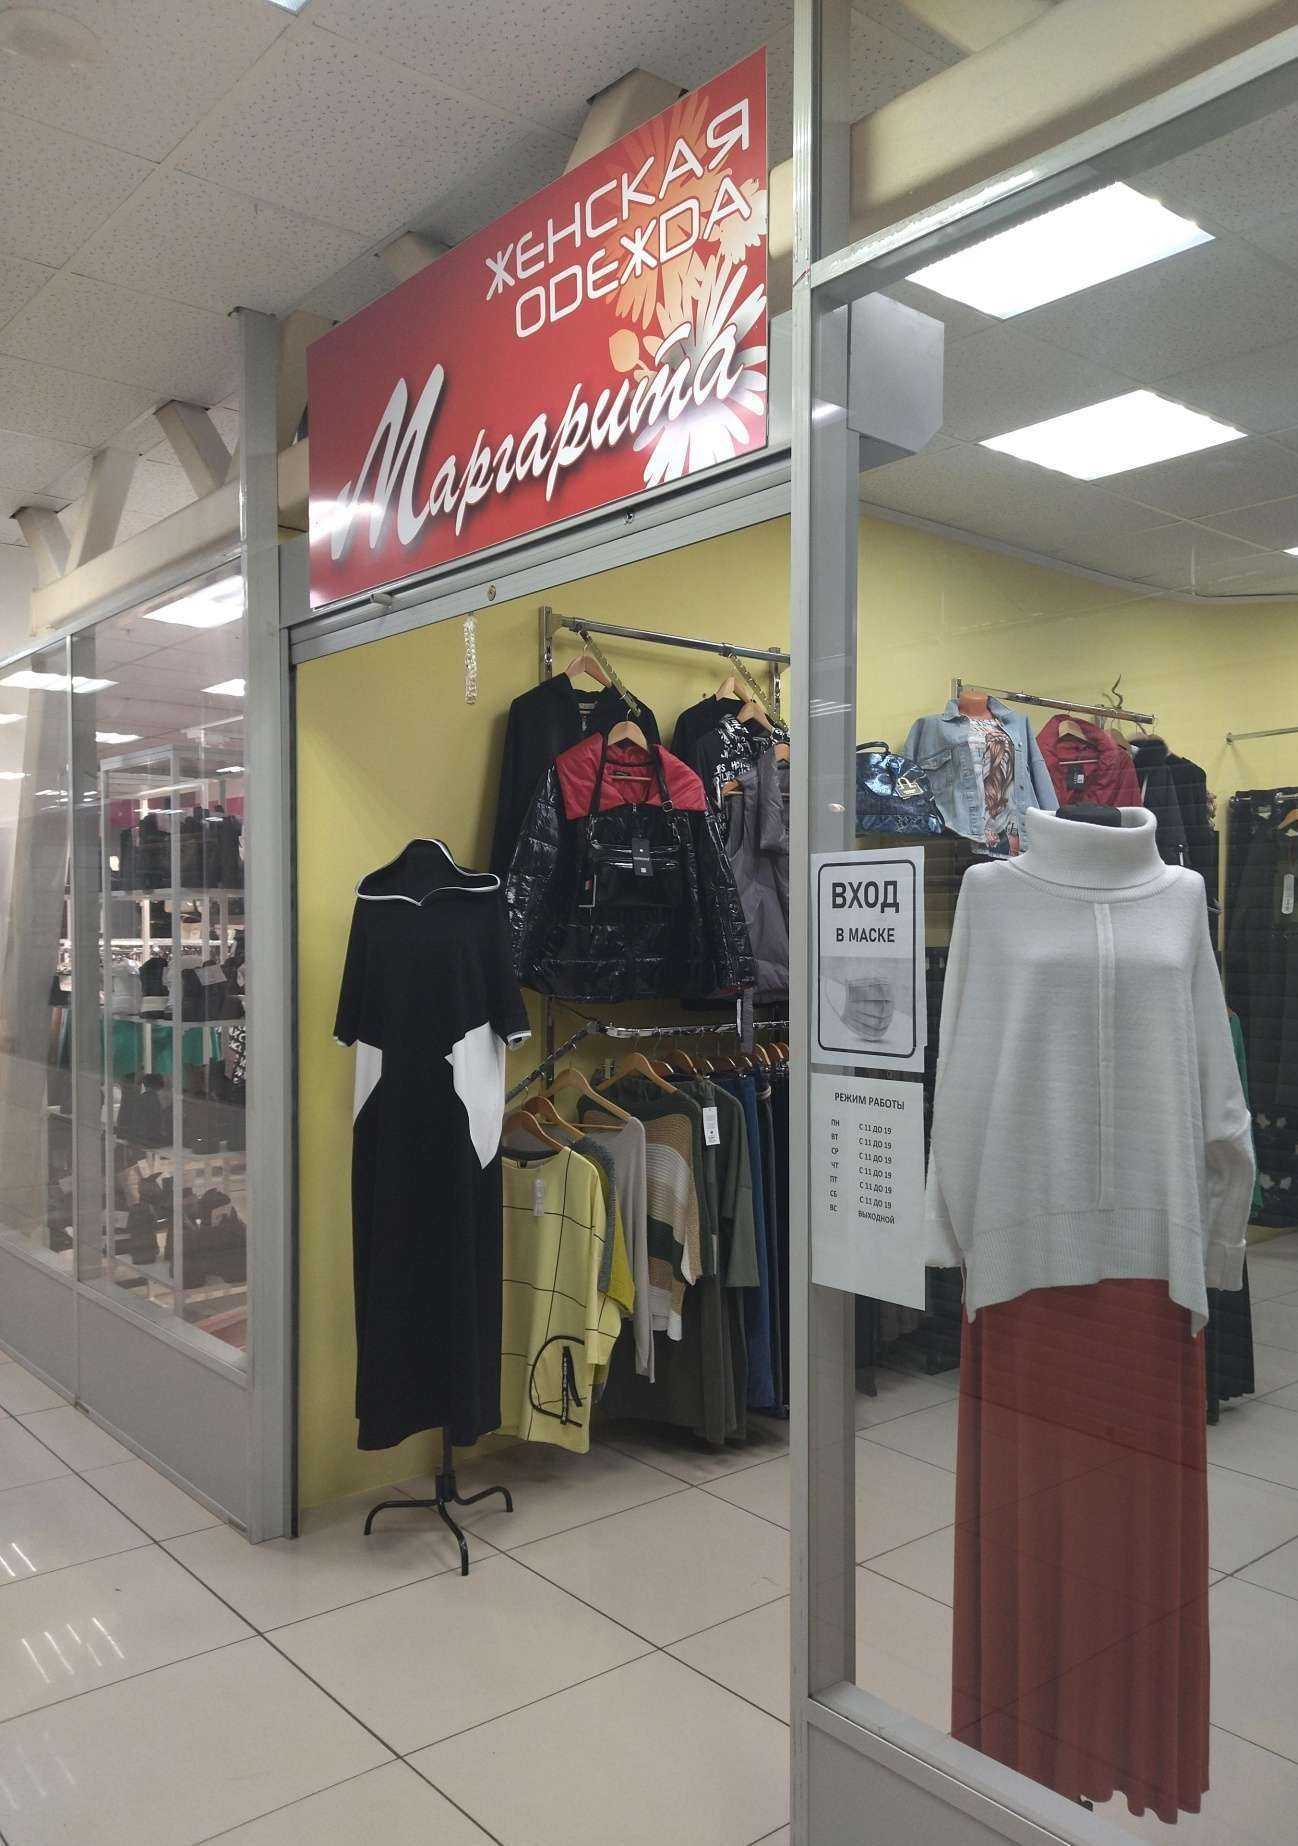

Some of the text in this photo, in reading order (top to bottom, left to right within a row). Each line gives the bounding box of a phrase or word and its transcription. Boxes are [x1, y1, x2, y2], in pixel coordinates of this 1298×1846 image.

[485, 98, 751, 301] ЖЕНСКАЯ
[515, 177, 752, 339] ОДЕЖДА
[331, 322, 745, 561] Маргарита
[831, 880, 900, 913] ВХОД
[836, 927, 896, 943] В МАСКЕ
[834, 1092, 905, 1110] РЕЖИМ РАБОТЫ
[831, 1119, 840, 1127] ПН
[865, 1124, 872, 1132] 11
[872, 1125, 883, 1134] ДО
[884, 1127, 892, 1135] 19
[831, 1133, 839, 1141] ВТ
[865, 1138, 872, 1147] 11
[872, 1140, 883, 1149] ДО
[884, 1141, 892, 1150] 19
[831, 1147, 839, 1155] СР
[865, 1153, 872, 1161] 11
[872, 1154, 883, 1164] ДО
[884, 1156, 892, 1165] 19
[831, 1161, 839, 1169] ЧТ
[865, 1167, 872, 1176] 11
[872, 1169, 884, 1179] ДО
[884, 1171, 892, 1180] 19
[829, 1175, 838, 1184] ПТ
[865, 1182, 873, 1191] 11
[873, 1183, 884, 1193] ДО
[884, 1186, 892, 1194] 19
[829, 1189, 838, 1198] СБ
[865, 1197, 873, 1205] 11
[872, 1198, 884, 1208] ДО
[884, 1201, 892, 1209] 19
[829, 1203, 895, 1224] ВС ВЫХОДНОЙ
